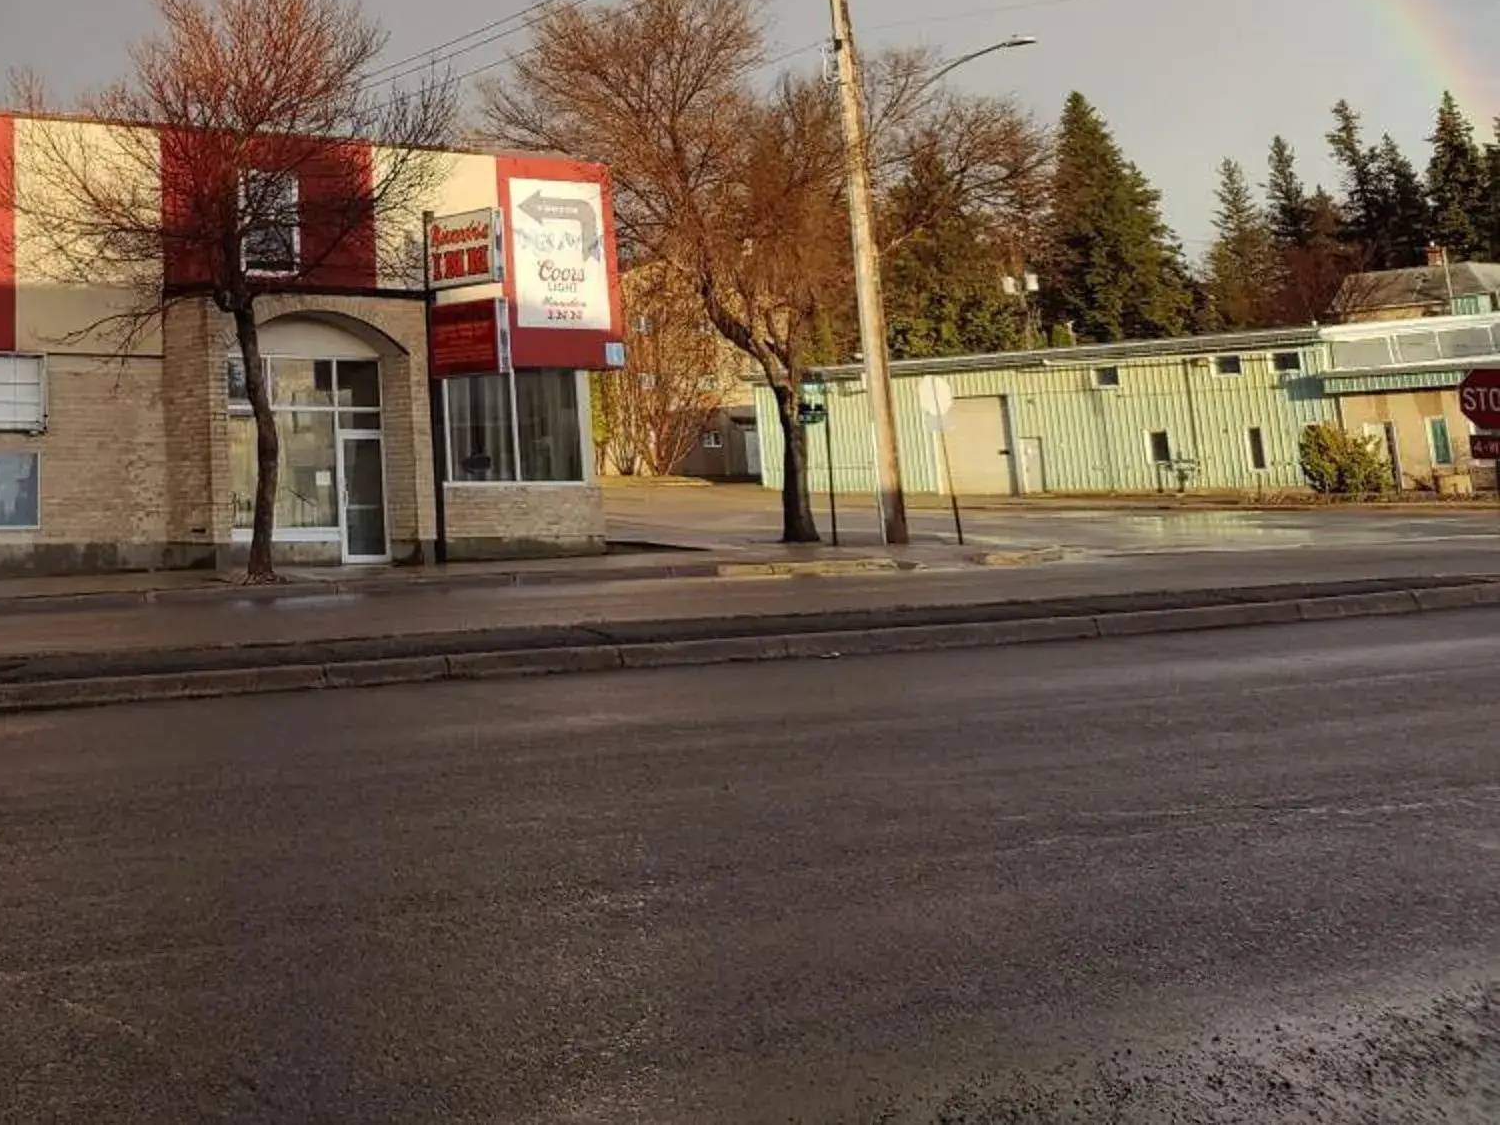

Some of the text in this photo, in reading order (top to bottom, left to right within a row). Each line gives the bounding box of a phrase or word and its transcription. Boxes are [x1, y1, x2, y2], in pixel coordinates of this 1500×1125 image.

[431, 245, 489, 281] INN
[537, 259, 585, 282] Coors
[547, 282, 578, 293] LIGHT
